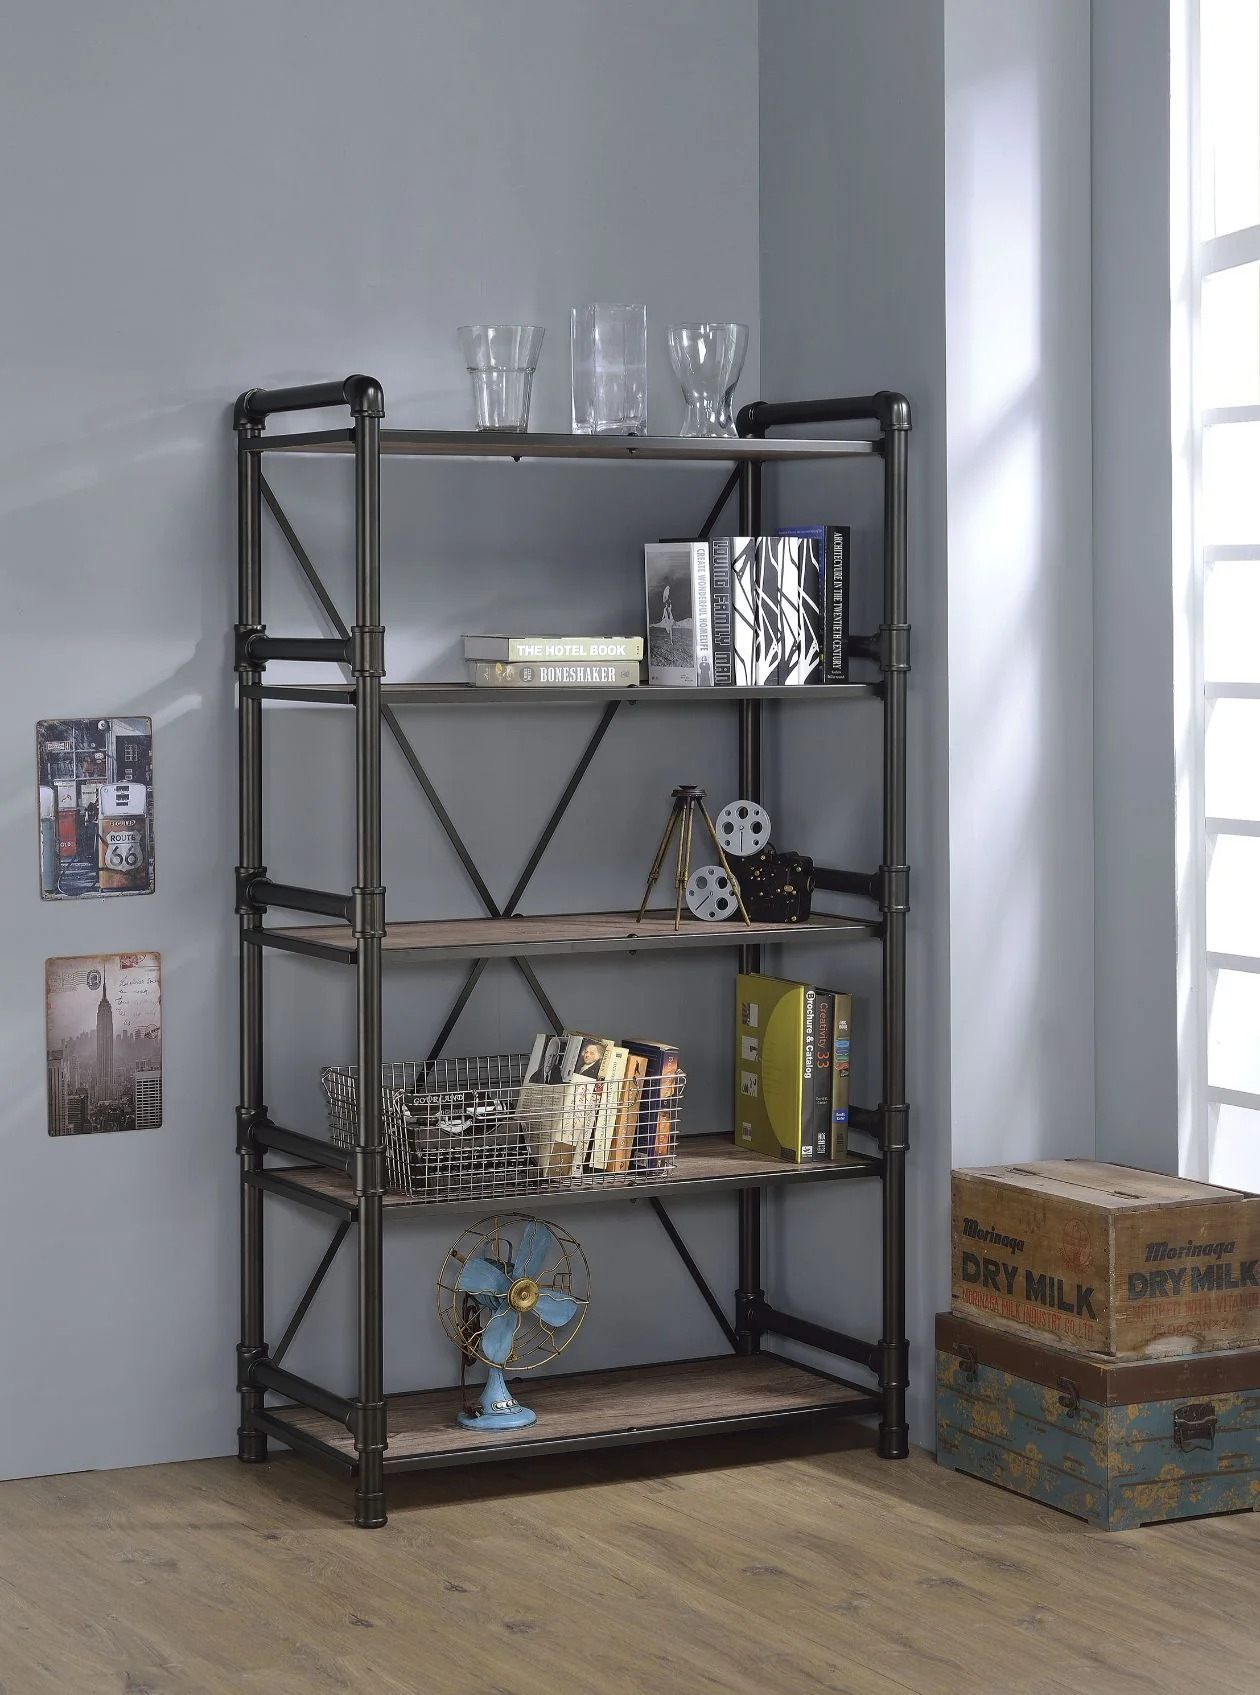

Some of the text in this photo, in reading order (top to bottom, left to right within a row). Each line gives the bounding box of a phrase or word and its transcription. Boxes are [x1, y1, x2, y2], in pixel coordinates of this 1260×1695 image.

[696, 548, 709, 652] CREATE WONDERFUL HOMELIFE
[833, 581, 843, 589] IN
[833, 589, 842, 601] THE
[713, 540, 731, 684] LOVING FAMILY MAN
[832, 602, 842, 639] TWENTIETH
[517, 644, 626, 656] THE HOTEL BOOK
[831, 640, 842, 669] CENTURY
[540, 667, 616, 682] BONESHAKER
[110, 834, 136, 842] ROUTE
[110, 845, 139, 867] 66
[804, 990, 816, 1079] Brochure & Catalog
[816, 1002, 830, 1069] Creativity 33
[963, 1217, 1025, 1255] Morinaga
[1144, 1240, 1236, 1262] Morinaga
[962, 1251, 1098, 1321] DRY MILK
[1127, 1259, 1260, 1301] DRY MILK
[962, 1287, 999, 1313] MORINAGA
[1001, 1297, 1020, 1320] MILK
[1023, 1304, 1061, 1331] INDUSTRY
